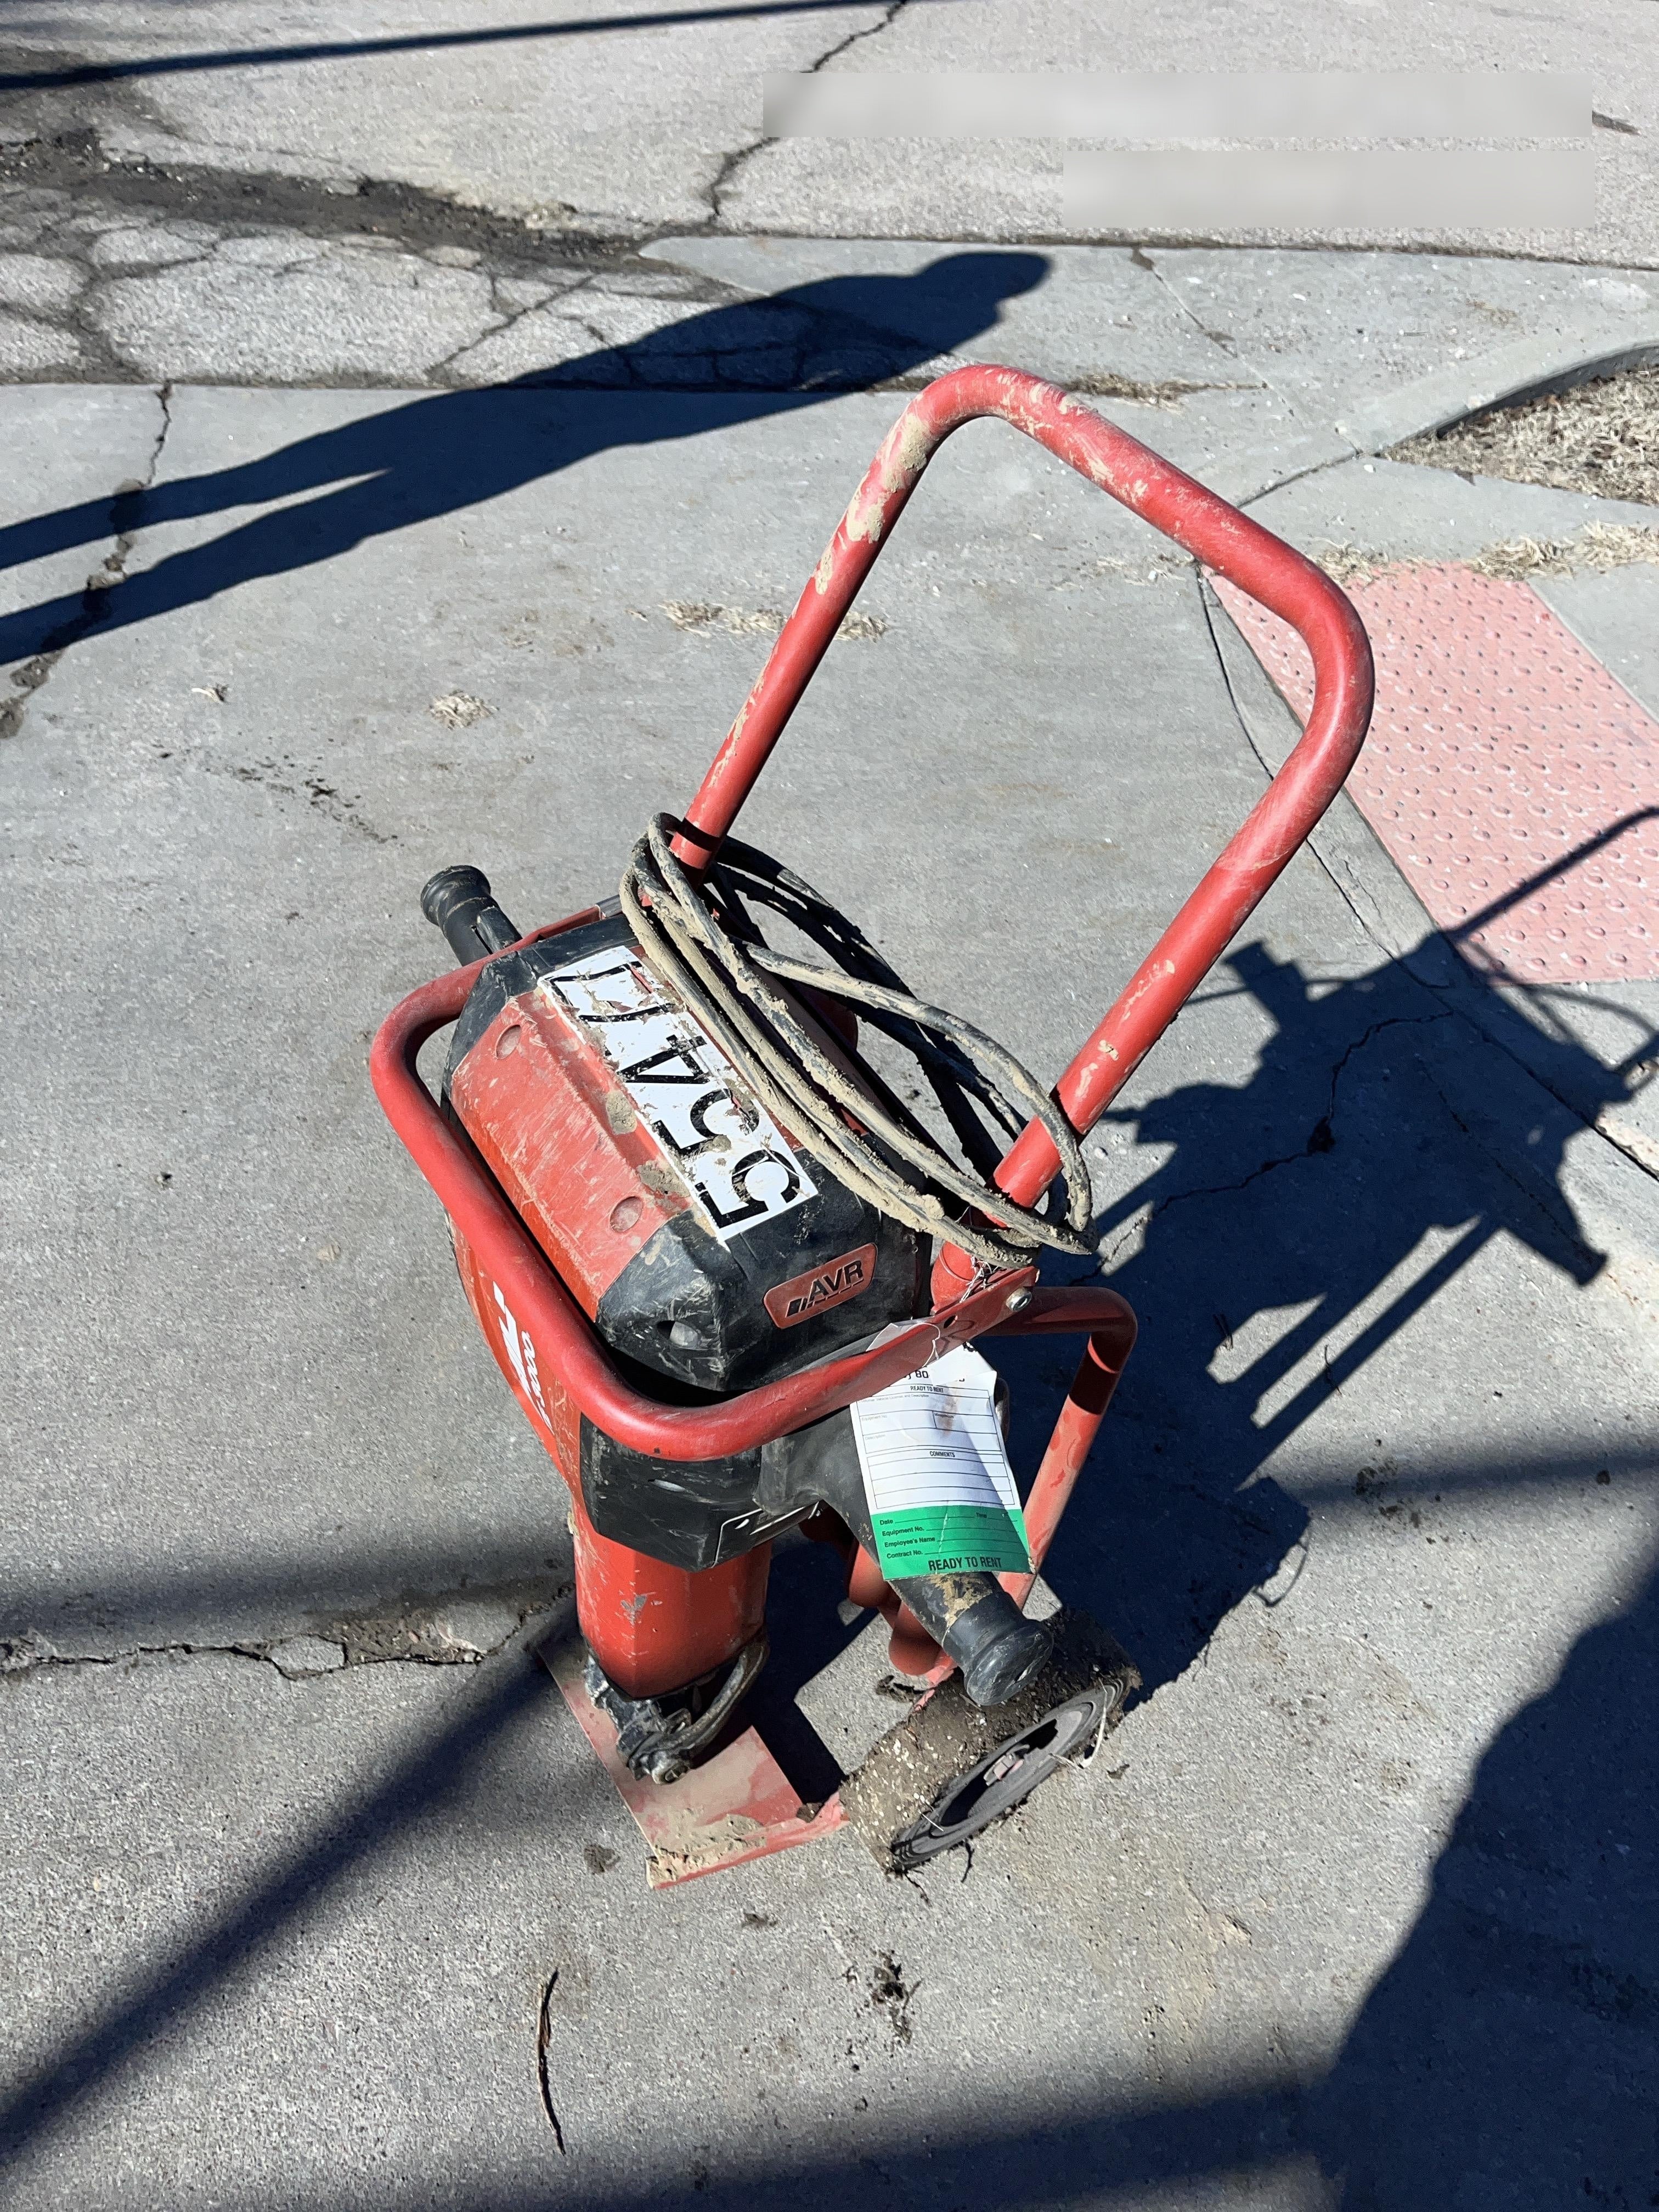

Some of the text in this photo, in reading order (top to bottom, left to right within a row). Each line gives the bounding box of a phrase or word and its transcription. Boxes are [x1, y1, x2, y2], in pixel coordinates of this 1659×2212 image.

[807, 1260, 864, 1302] AVR
[882, 1528, 913, 1537] Equipment
[884, 1539, 918, 1548] Employee's
[928, 1556, 1001, 1571] READY TO RENT
